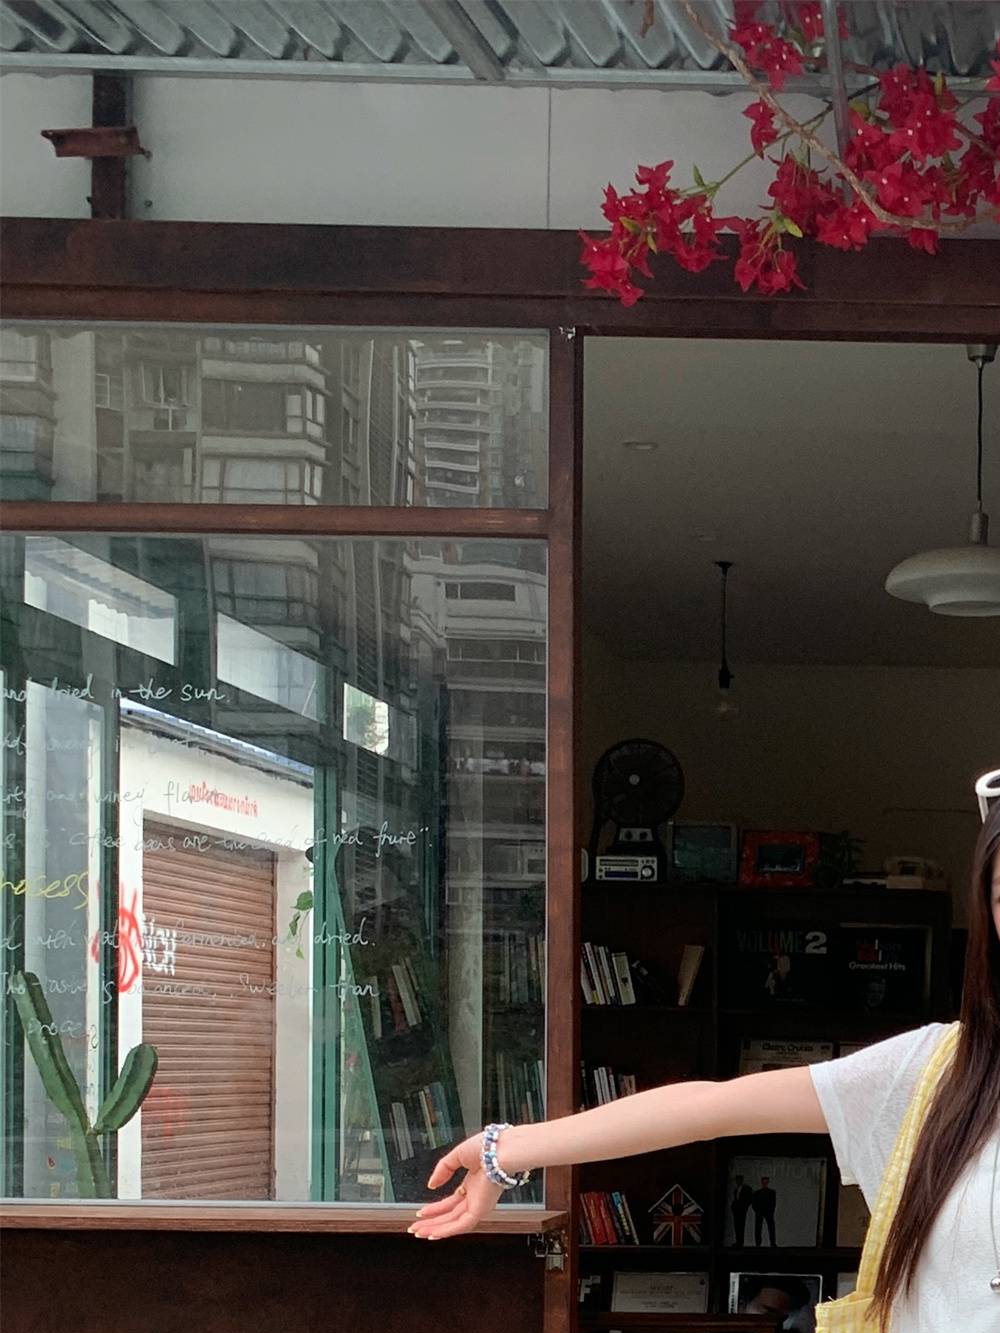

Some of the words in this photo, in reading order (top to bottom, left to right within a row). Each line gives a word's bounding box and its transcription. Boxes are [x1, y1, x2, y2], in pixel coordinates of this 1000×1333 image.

[111, 682, 122, 698] in
[129, 678, 172, 701] the
[183, 836, 211, 852] are
[0, 868, 89, 910] rocess
[736, 929, 803, 953] VOLUME
[804, 931, 828, 954] 2
[848, 961, 888, 970] Greatest
[888, 962, 906, 971] Hits
[102, 973, 117, 1004] is
